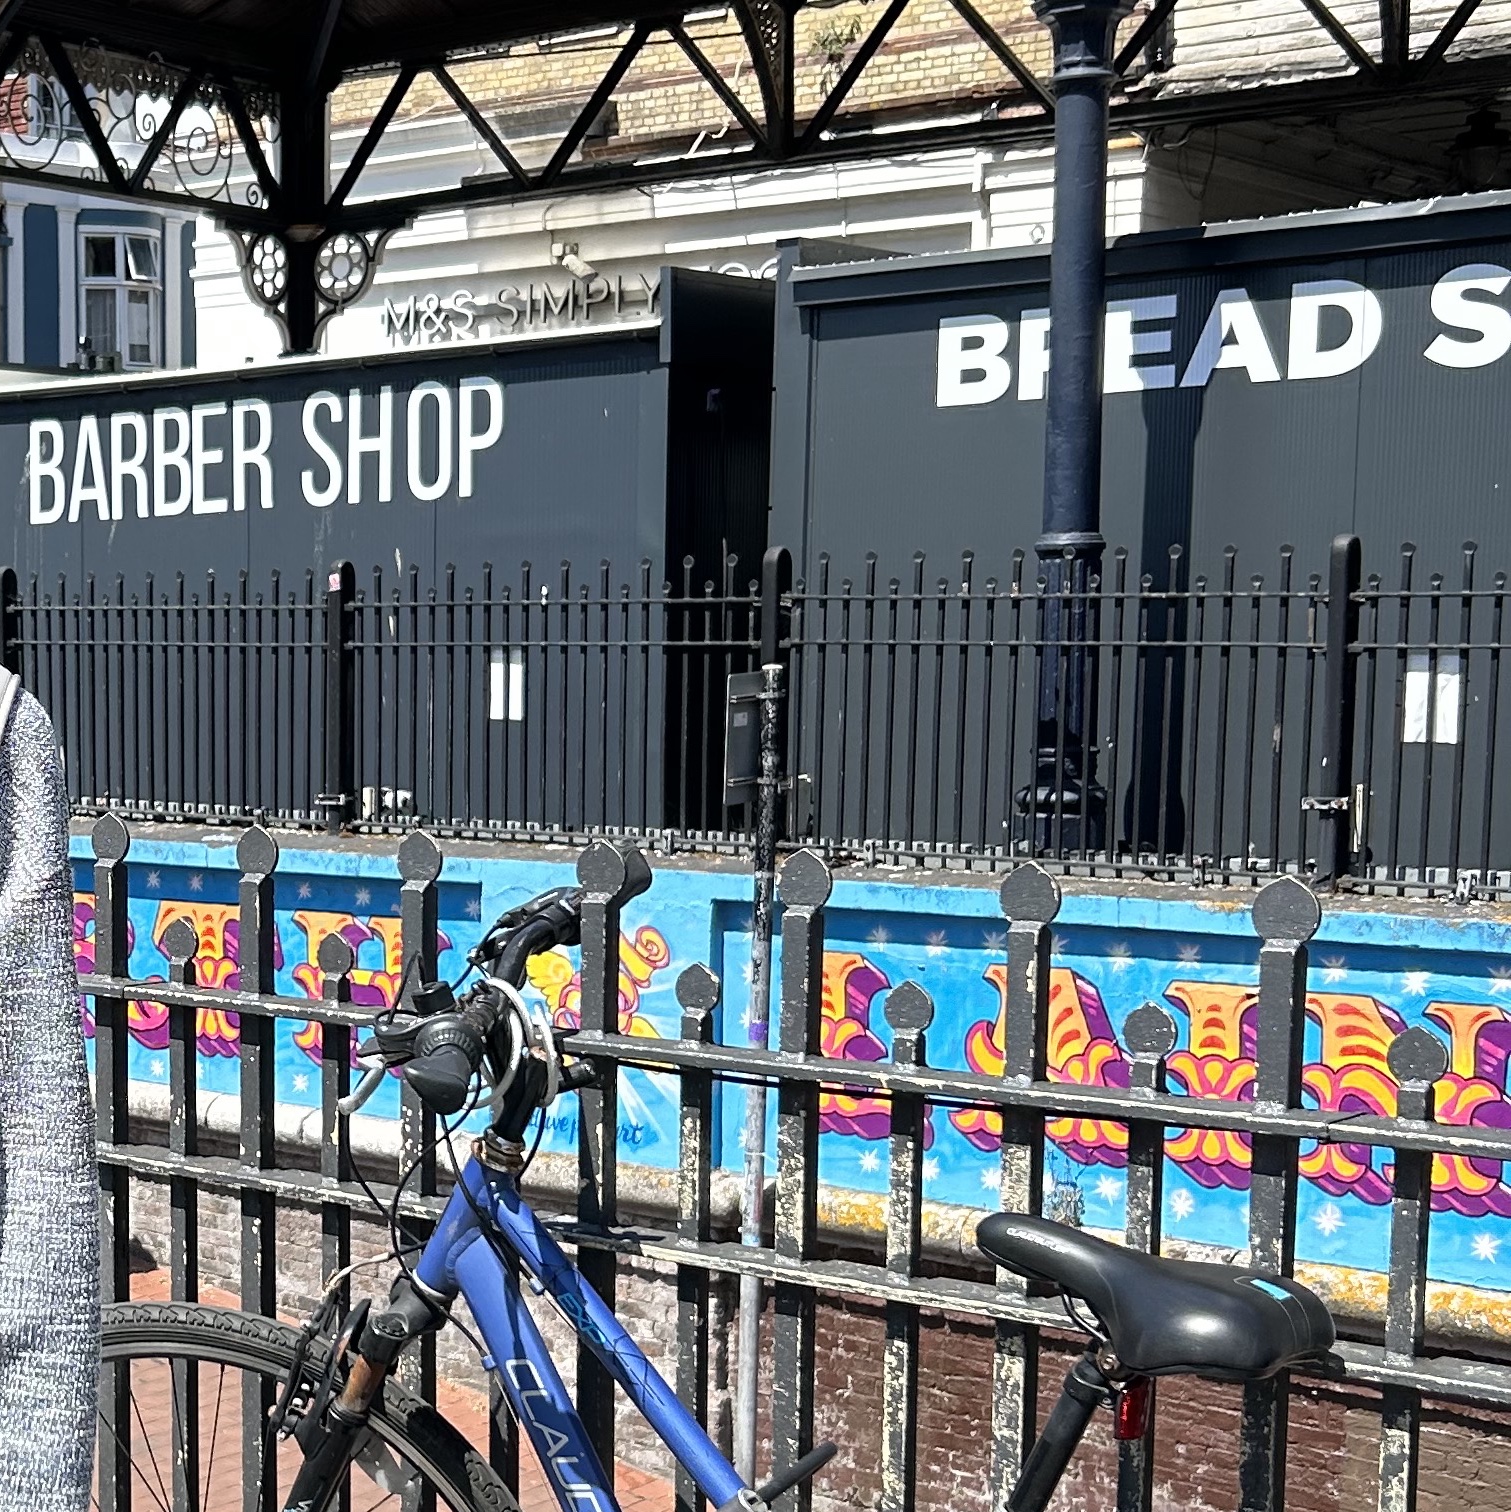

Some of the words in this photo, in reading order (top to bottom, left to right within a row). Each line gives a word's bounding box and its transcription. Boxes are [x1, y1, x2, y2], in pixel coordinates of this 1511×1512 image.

[383, 288, 476, 338] M&S
[495, 272, 662, 329] SIMPLY
[28, 397, 275, 526] BARBER
[300, 375, 505, 508] SHOP
